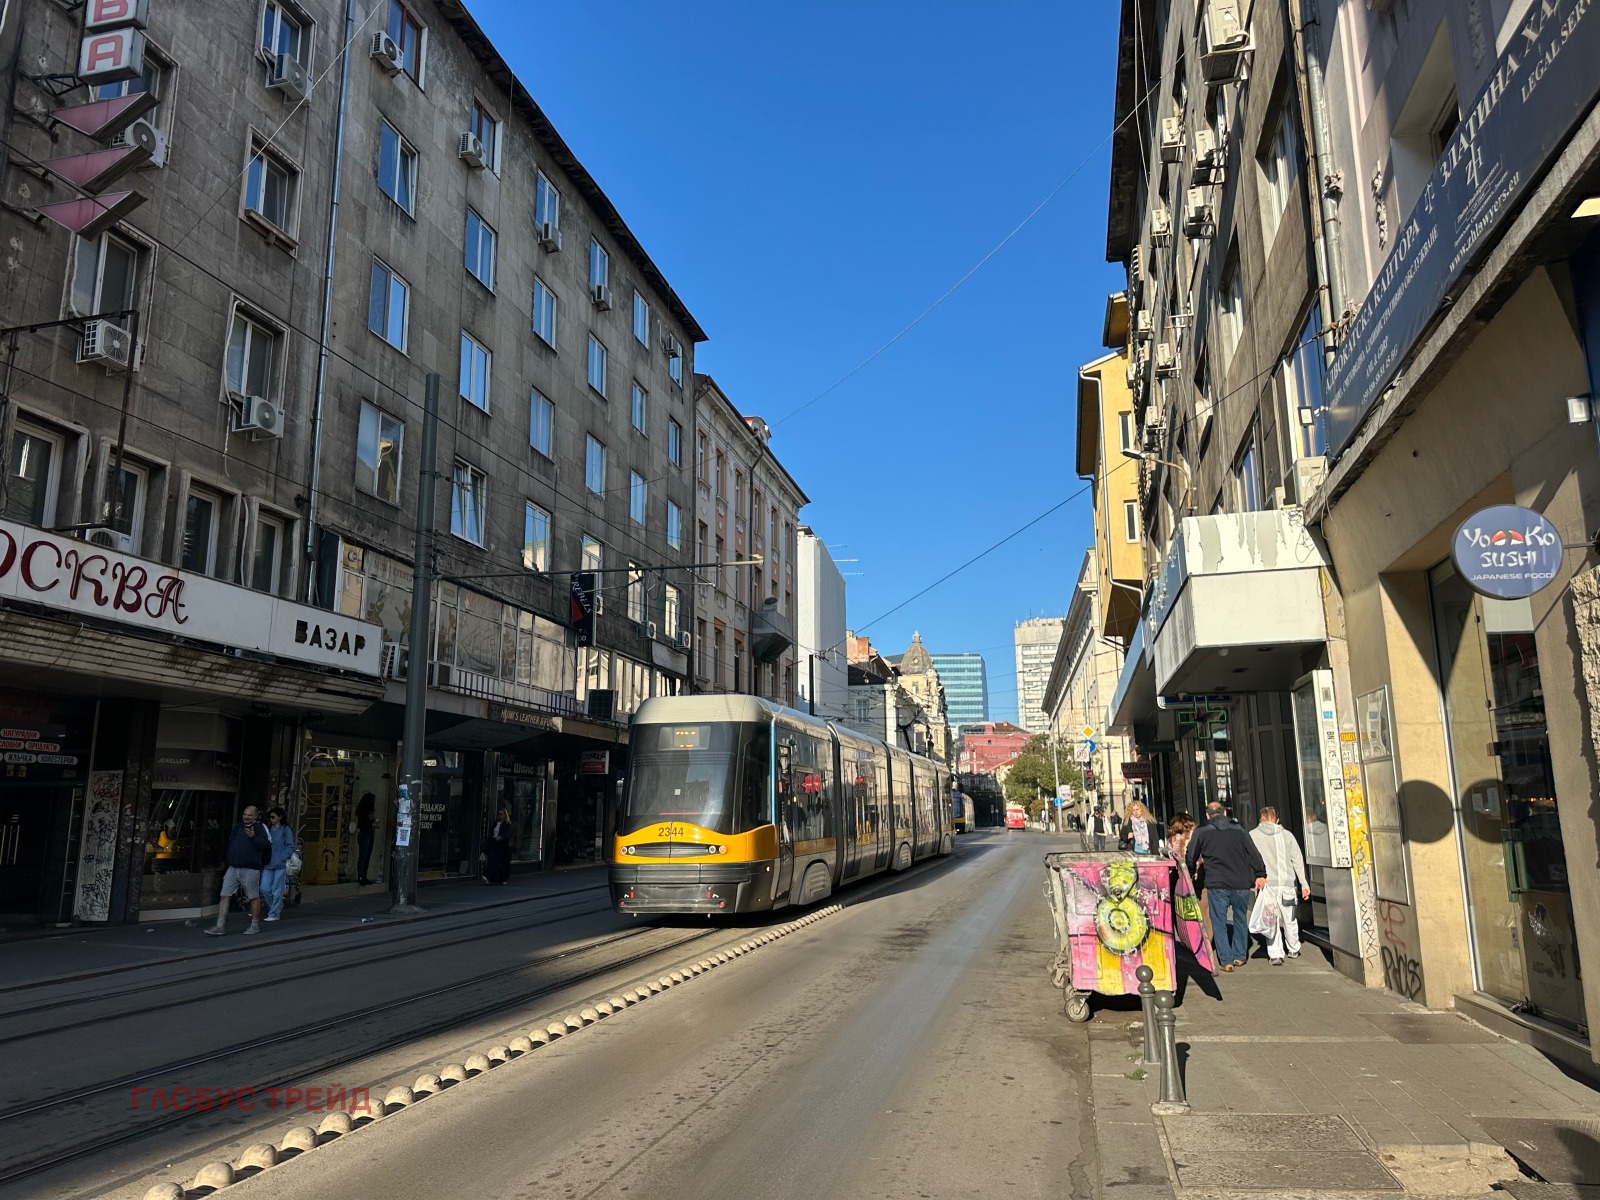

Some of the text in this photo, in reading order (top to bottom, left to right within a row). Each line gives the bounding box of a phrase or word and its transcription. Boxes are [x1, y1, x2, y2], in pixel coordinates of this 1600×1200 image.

[1520, 39, 1560, 104] LEGAL
[1325, 305, 1373, 394] АДВОКАТСКА
[1373, 217, 1421, 309] КАНТОРА
[1440, 53, 1521, 188] ЗЛАТИНА
[1449, 171, 1520, 273] www.zhlawyers.eu
[1524, 525, 1555, 546] Ko
[1480, 550, 1537, 568] SUSHI
[295, 619, 366, 657] БАЗАР
[3, 729, 38, 739] НАТУРАЛНИ
[28, 742, 58, 752] ПРОДУКТИ
[658, 827, 684, 837] 2344
